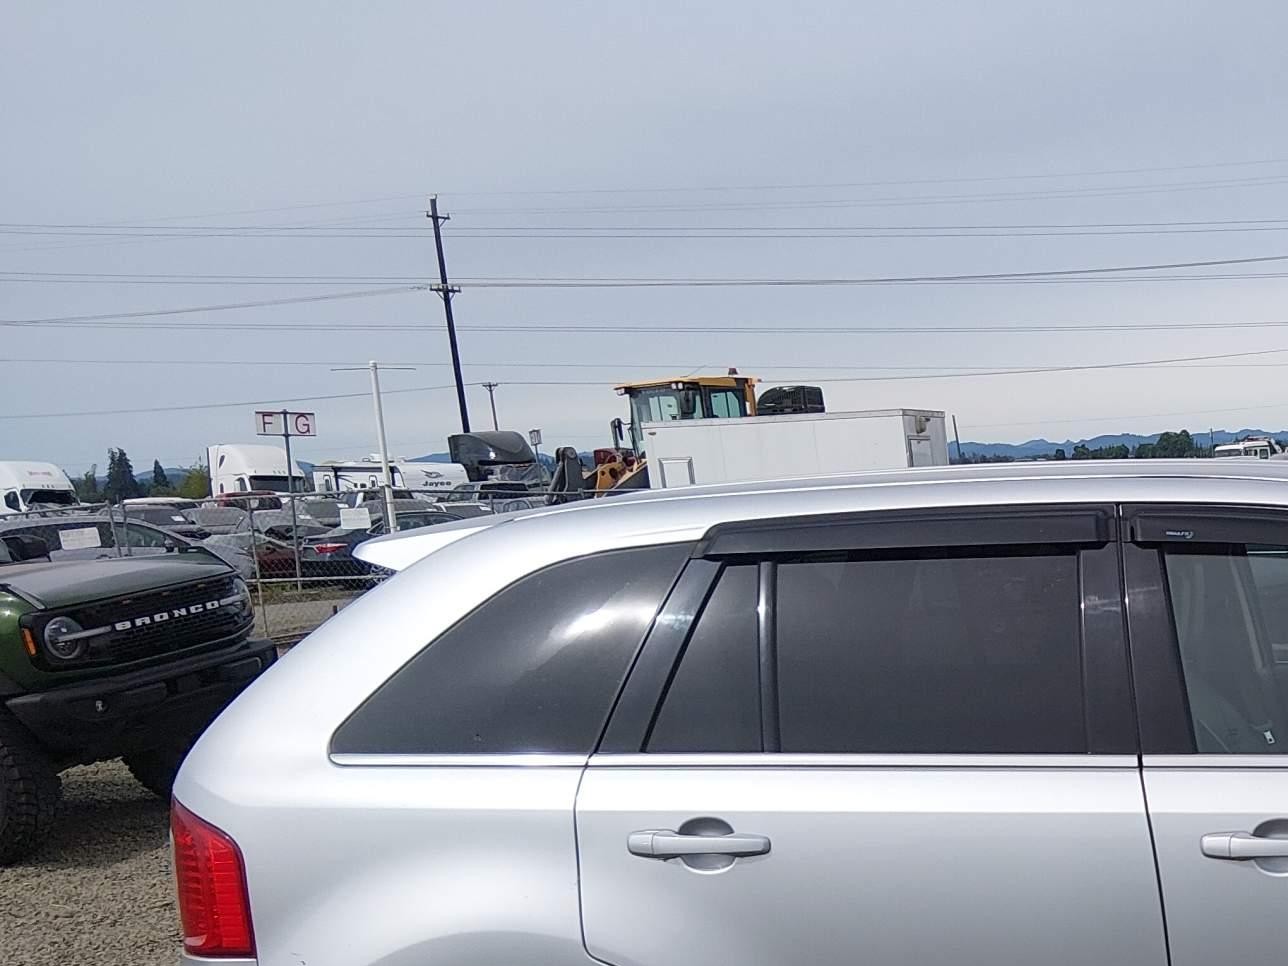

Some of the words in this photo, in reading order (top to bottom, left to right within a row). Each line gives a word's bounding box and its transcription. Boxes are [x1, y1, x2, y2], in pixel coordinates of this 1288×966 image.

[262, 414, 276, 433] F
[295, 414, 310, 435] G
[422, 481, 452, 489] Jayco
[115, 600, 220, 632] BRONCO
